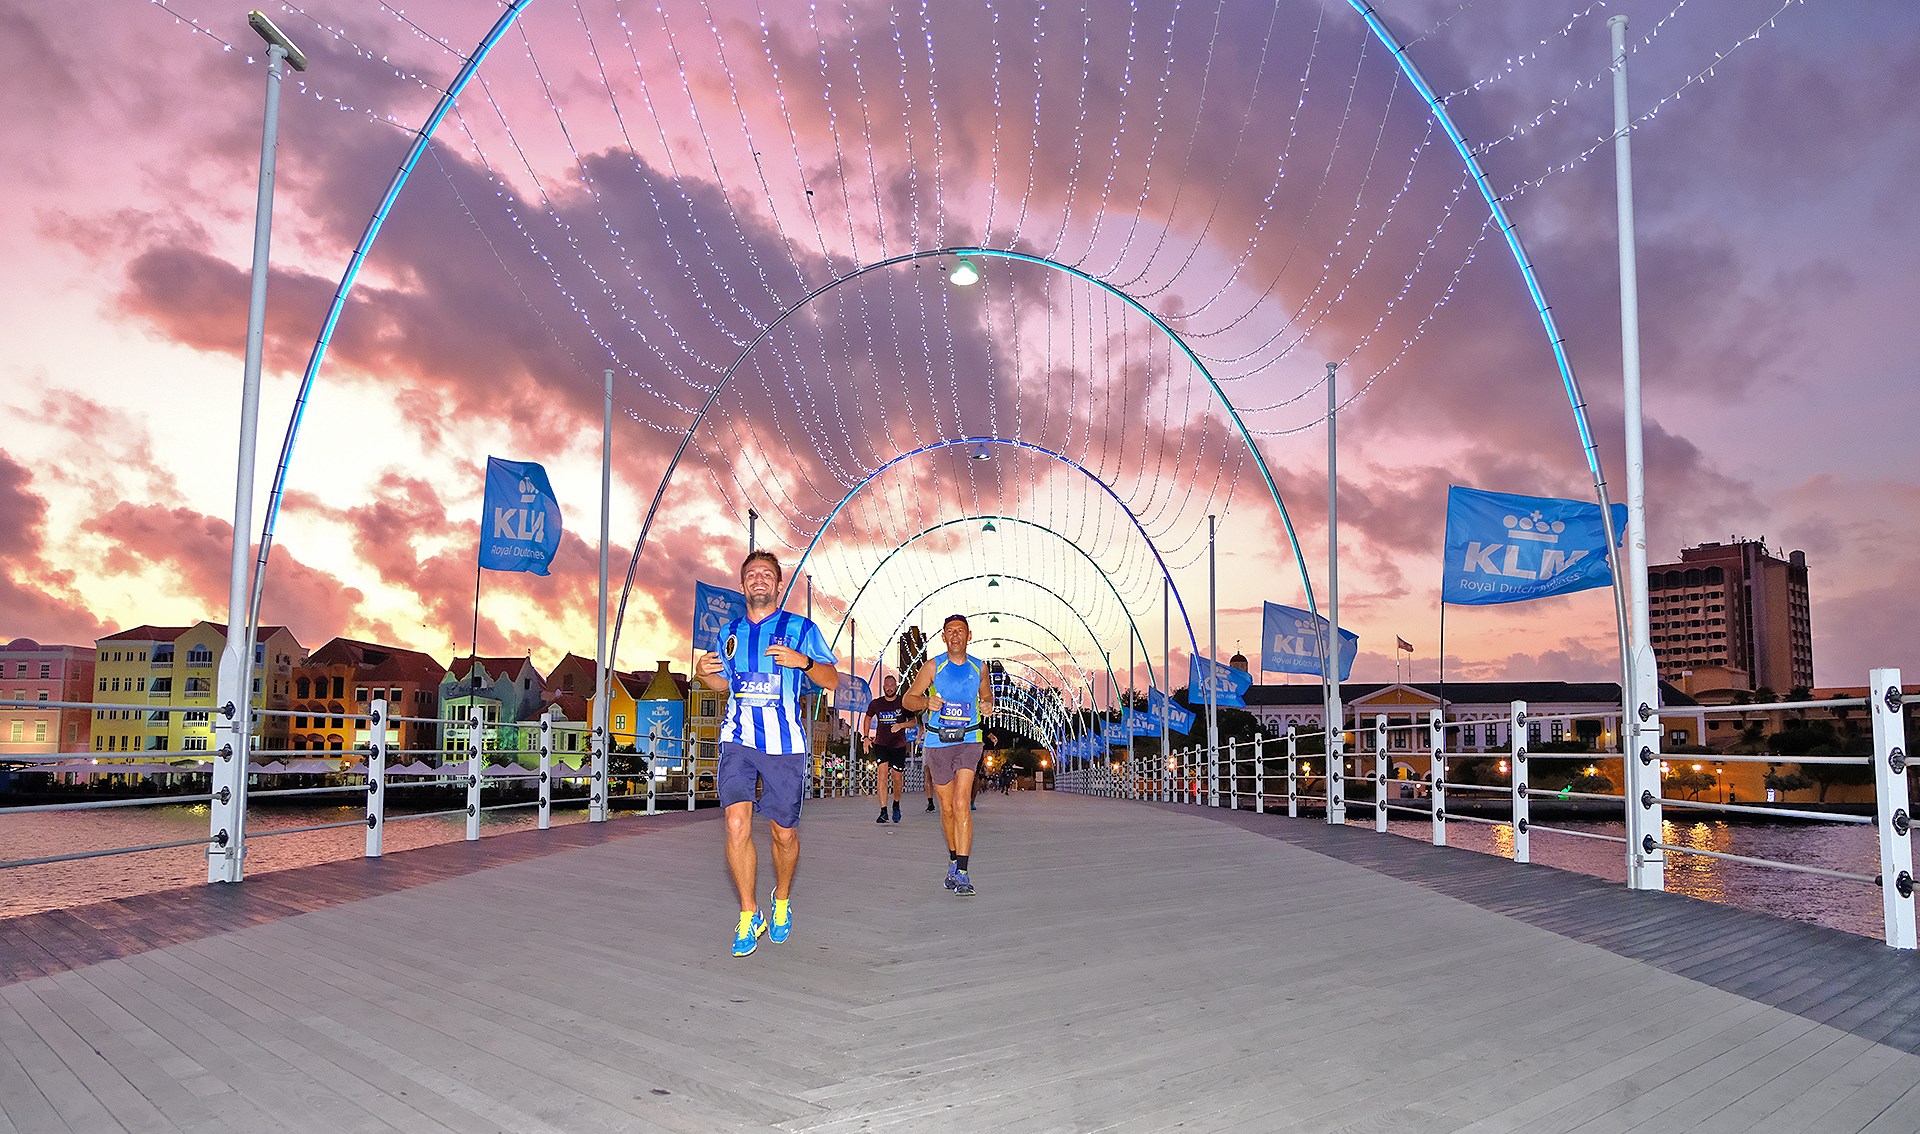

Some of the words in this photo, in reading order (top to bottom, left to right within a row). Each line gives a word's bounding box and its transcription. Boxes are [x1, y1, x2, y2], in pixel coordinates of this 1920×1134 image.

[491, 545, 512, 556] Royal
[1463, 541, 1589, 580] KLM
[1460, 579, 1496, 593] Royal
[1499, 583, 1536, 594] Dutch
[740, 681, 772, 694] 2548
[945, 707, 963, 717] 300
